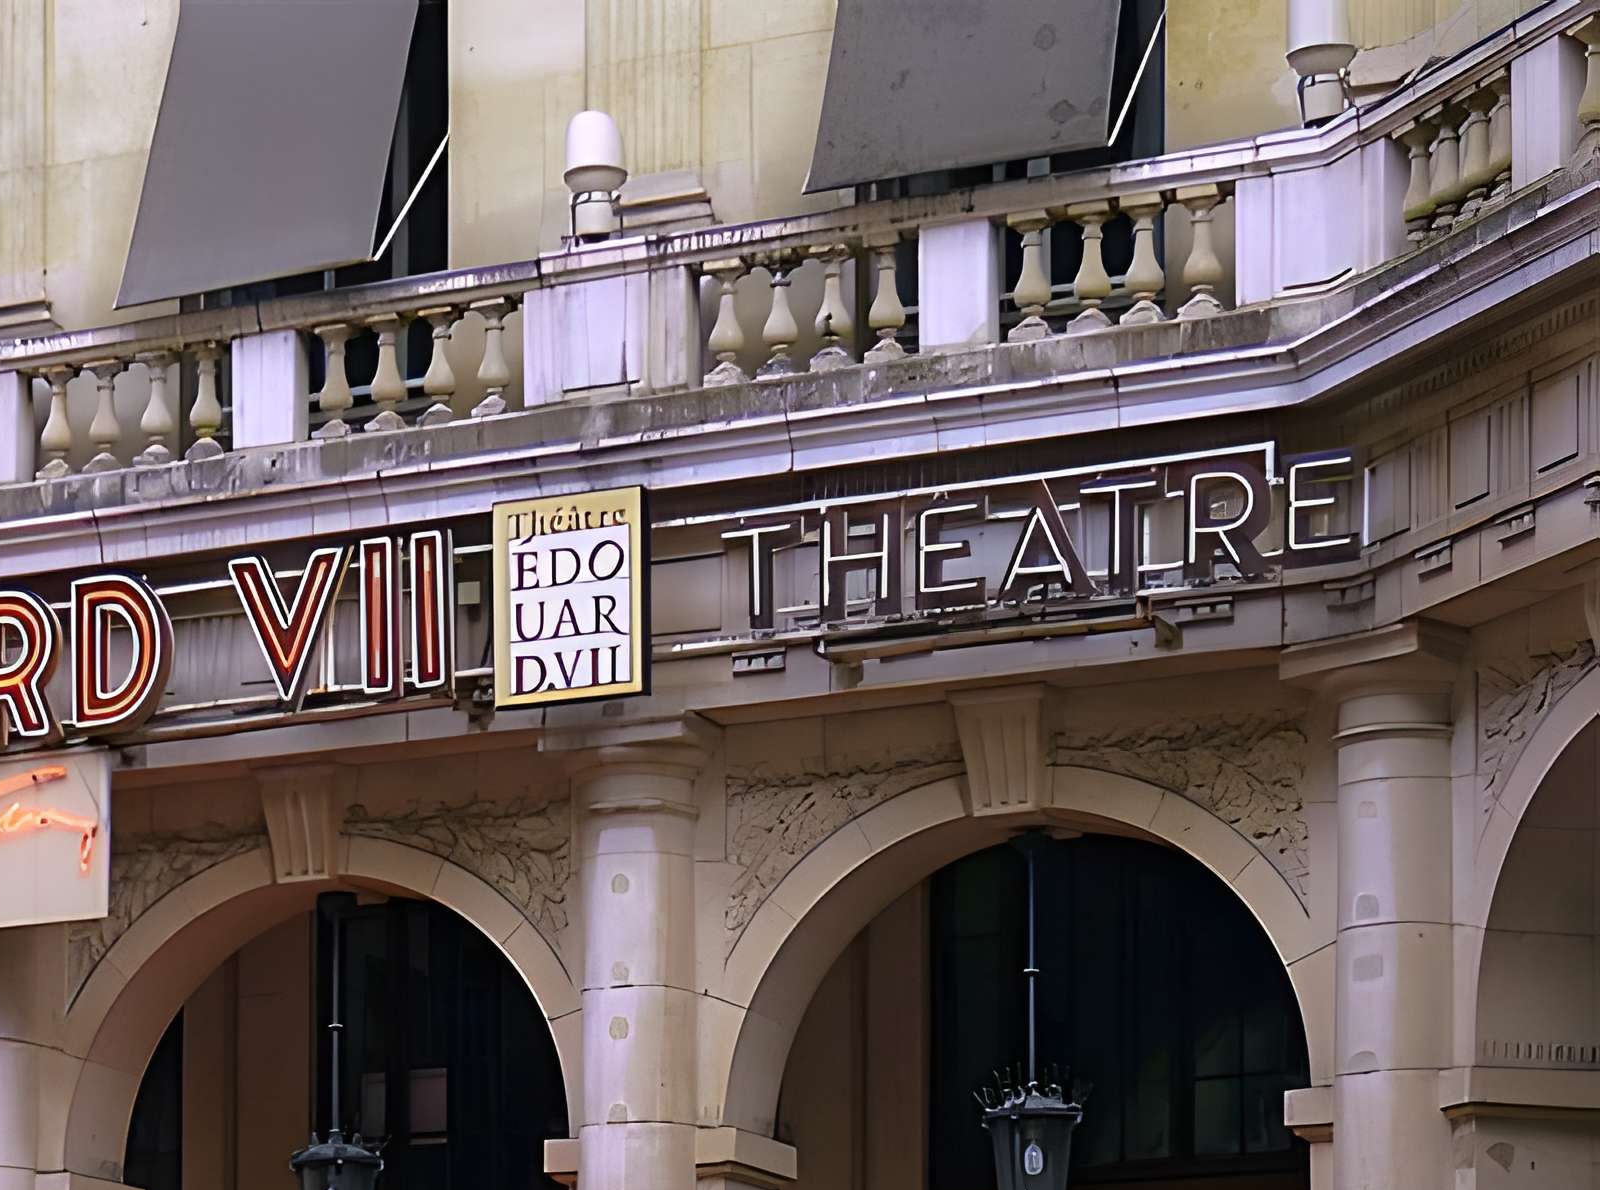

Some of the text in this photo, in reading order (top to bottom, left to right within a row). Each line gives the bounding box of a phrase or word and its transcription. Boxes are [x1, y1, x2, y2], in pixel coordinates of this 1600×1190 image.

[228, 530, 450, 701] VII
[515, 595, 628, 642] UAR
[720, 452, 1356, 626] THEATRE
